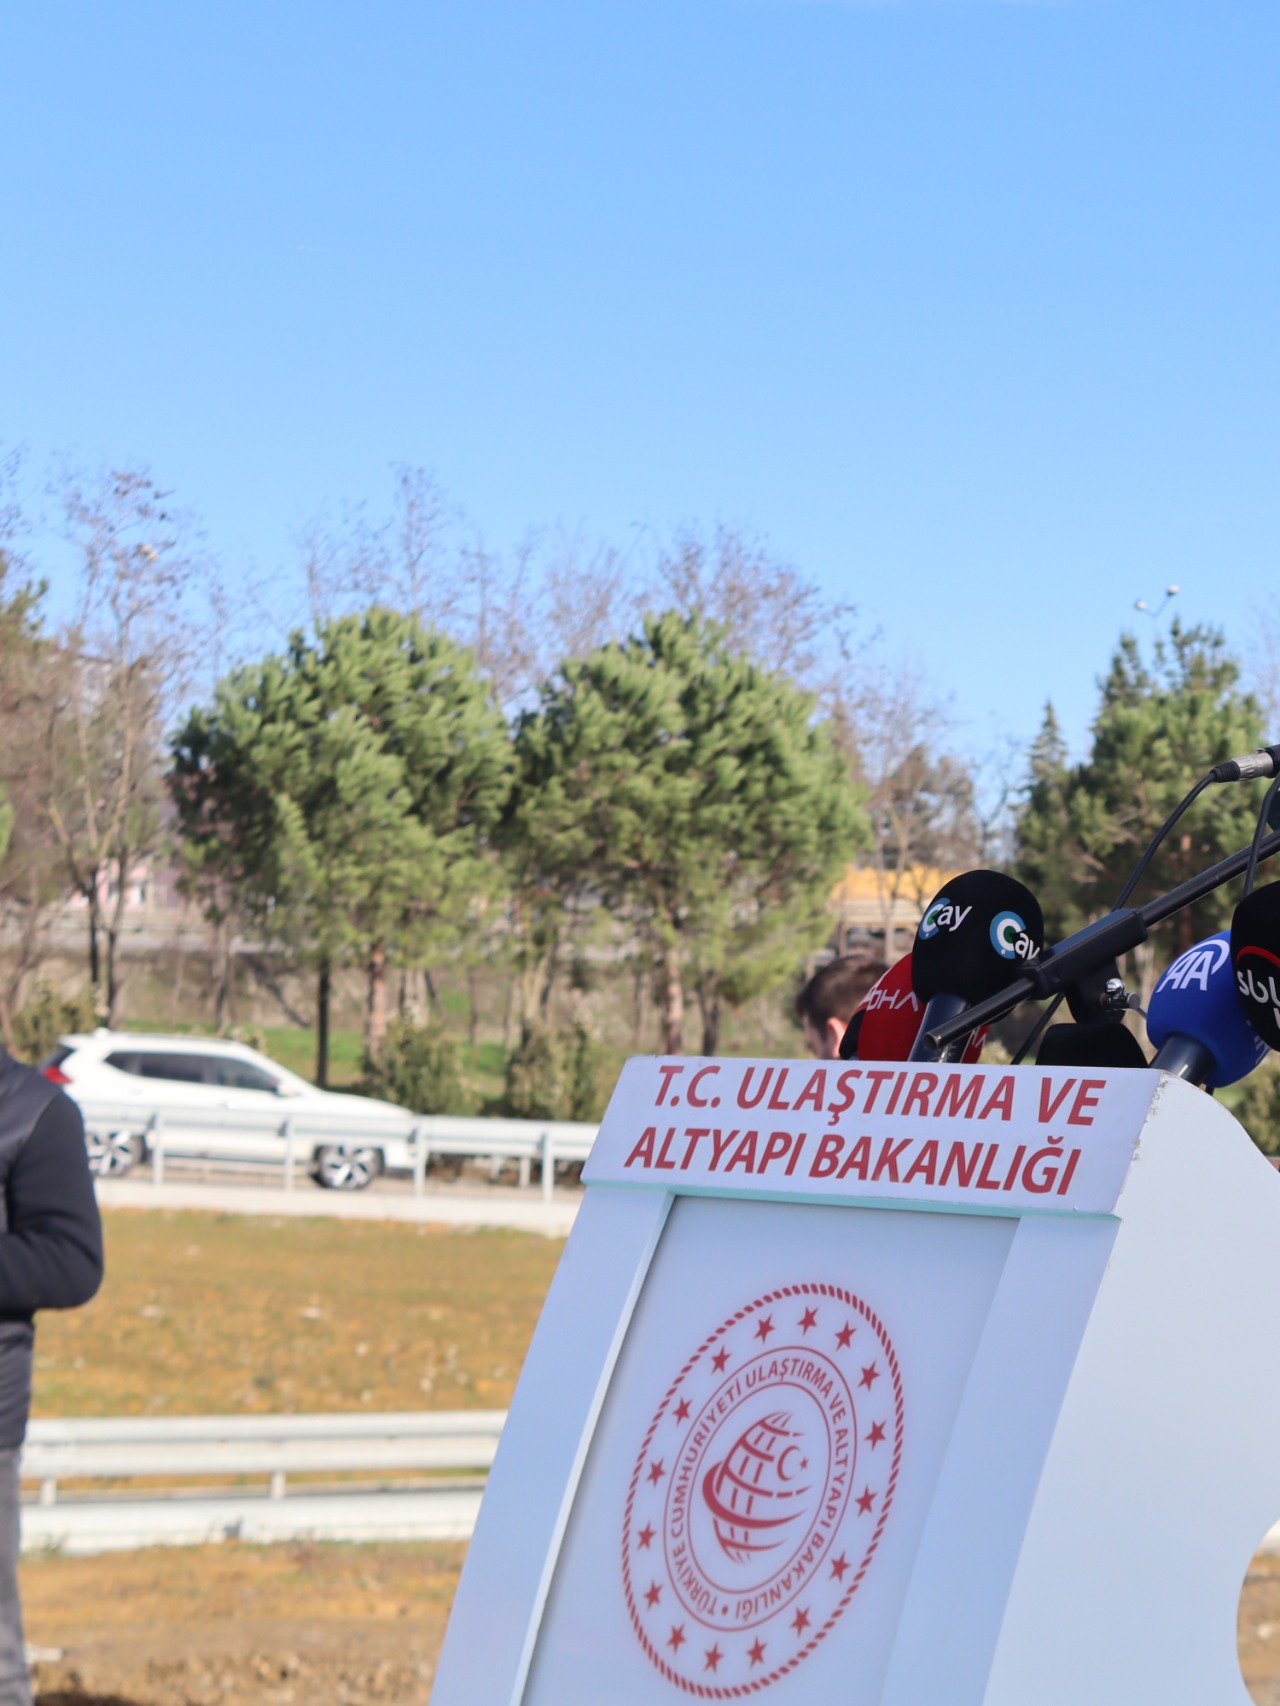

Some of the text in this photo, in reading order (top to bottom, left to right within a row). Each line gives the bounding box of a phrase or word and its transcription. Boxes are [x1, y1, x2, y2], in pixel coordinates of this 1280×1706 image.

[1156, 950, 1216, 993] AA
[655, 1065, 1106, 1126] T.C. ULAŞTIRMA VE
[624, 1127, 1081, 1195] ALTYAPI BAKANLIĞI
[745, 1358, 833, 1399] ULAŞTIRMA
[829, 1392, 847, 1425] VE
[820, 1428, 849, 1529] ALTYAPI
[735, 1532, 824, 1622] BAKANLIĞI
